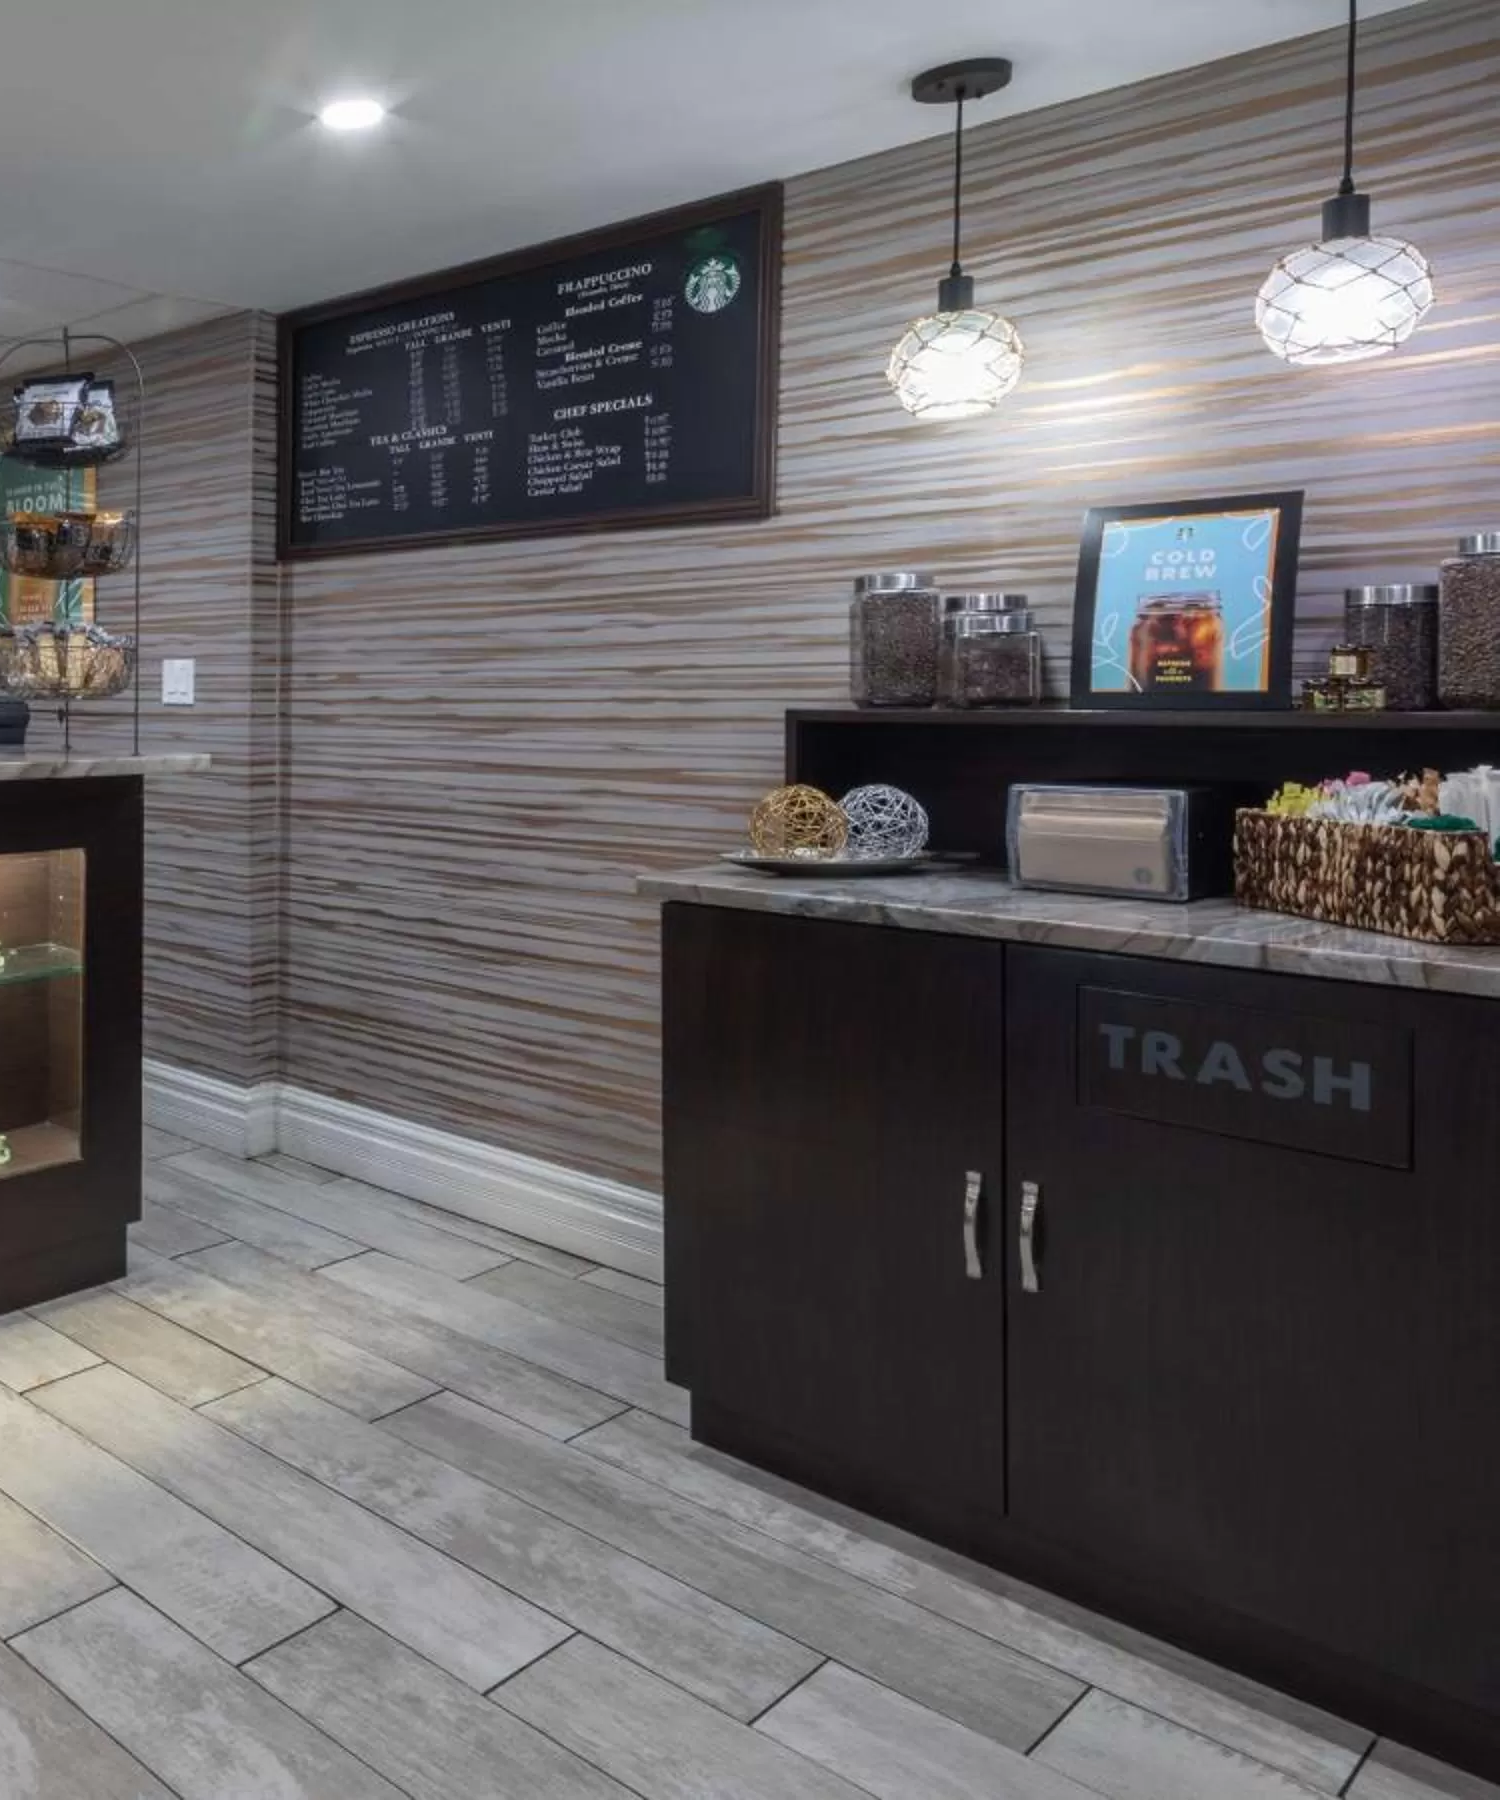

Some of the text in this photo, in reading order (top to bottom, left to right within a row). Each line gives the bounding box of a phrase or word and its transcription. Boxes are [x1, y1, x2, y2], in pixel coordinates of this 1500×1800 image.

[557, 263, 653, 295] FRAPPUCCINO
[565, 294, 643, 317] Blended Coffee
[553, 393, 653, 420] CHEF SPECIALS
[1151, 548, 1216, 565] COLD
[1145, 563, 1218, 581] BREW
[1099, 1023, 1371, 1112] TRASH
